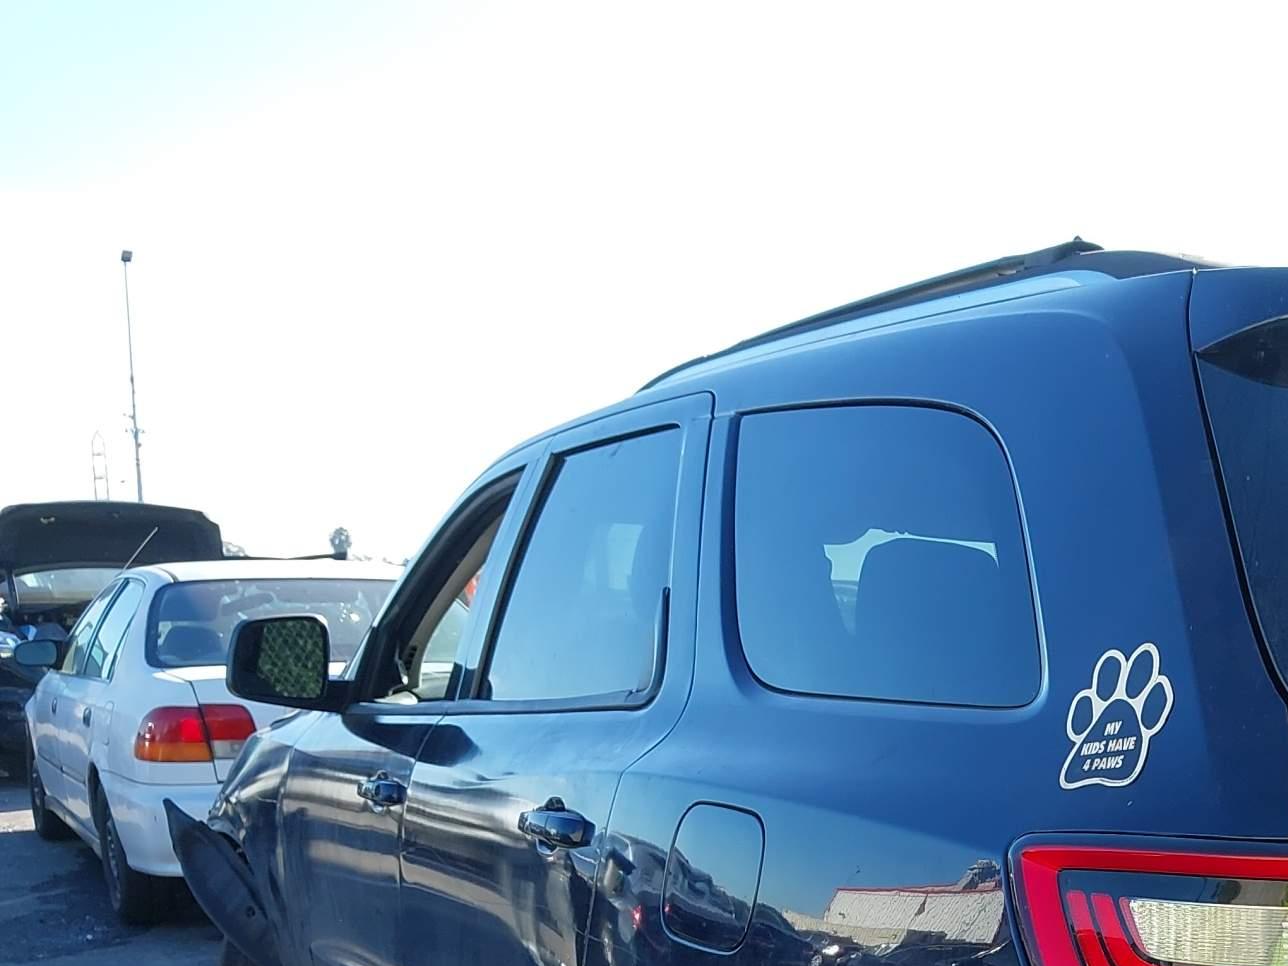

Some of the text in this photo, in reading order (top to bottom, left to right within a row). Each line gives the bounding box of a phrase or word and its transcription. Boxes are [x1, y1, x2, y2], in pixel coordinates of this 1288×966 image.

[1104, 721, 1122, 736] MY
[1080, 736, 1137, 757] KIDS HAVE
[1082, 755, 1125, 772] 4 PAWS
